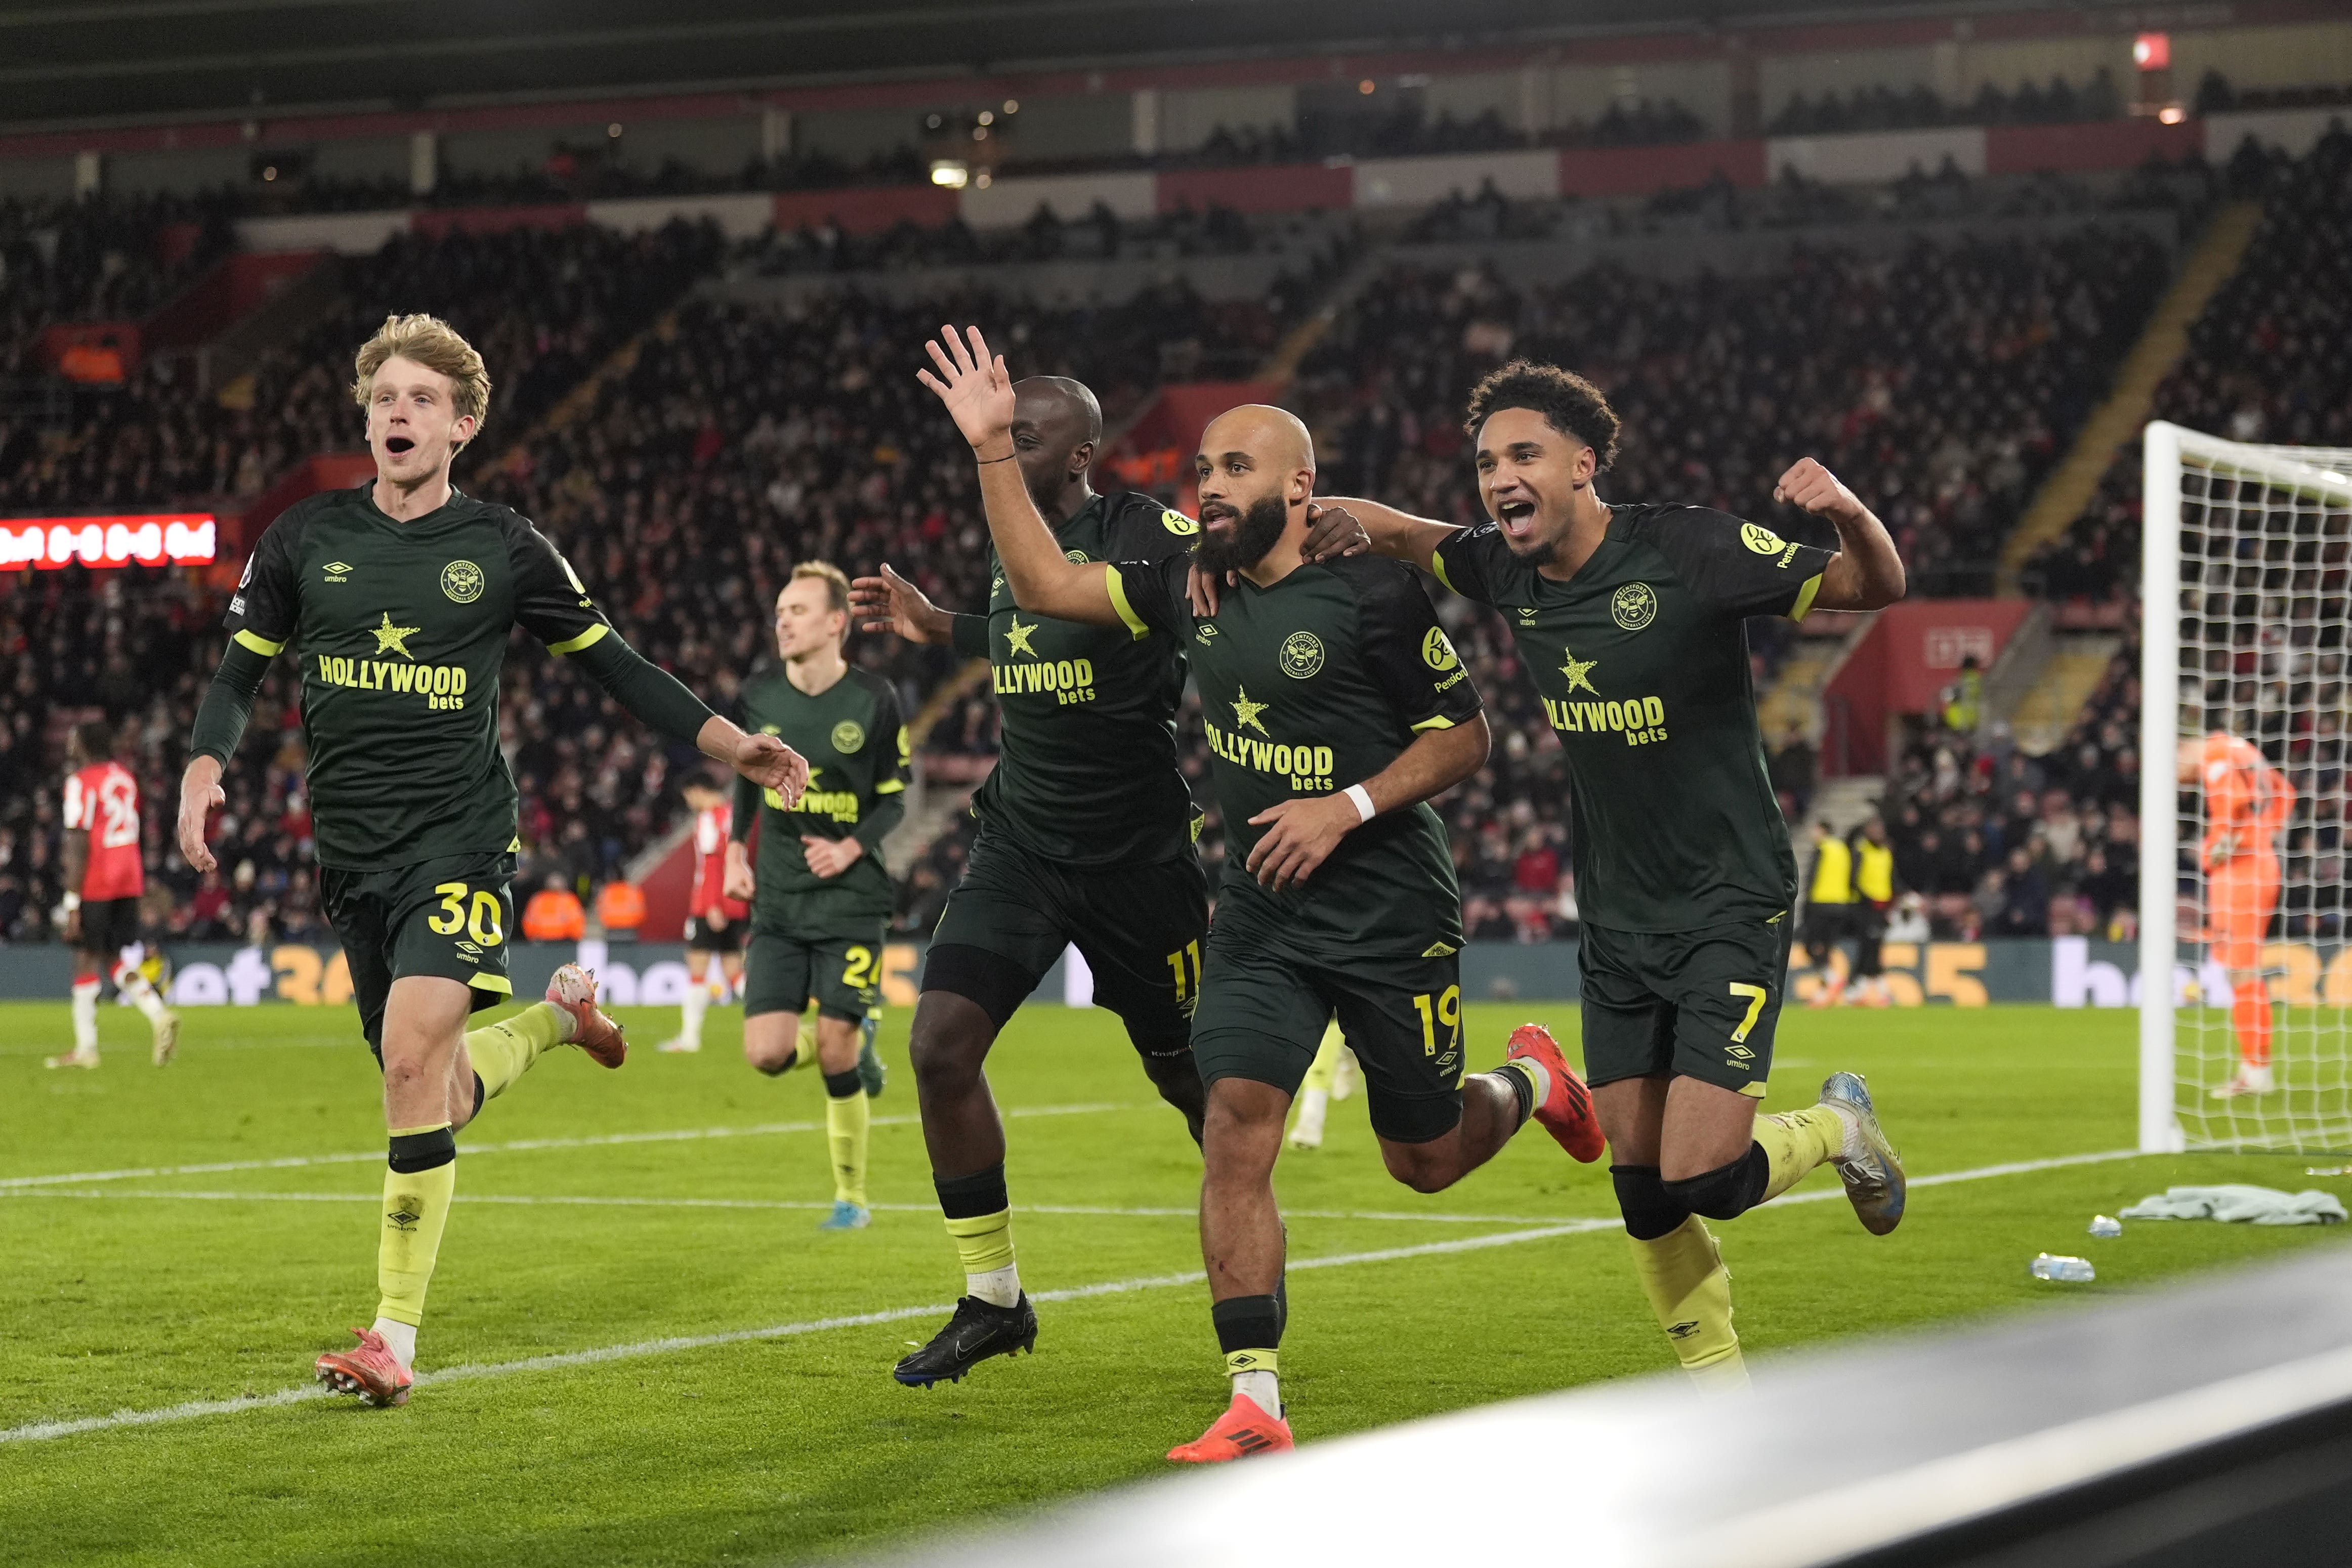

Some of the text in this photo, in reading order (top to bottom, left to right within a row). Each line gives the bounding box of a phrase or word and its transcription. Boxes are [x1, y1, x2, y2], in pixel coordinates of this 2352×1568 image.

[1068, 553, 1085, 561] NTFORD
[447, 563, 479, 575] BRENTFORD
[324, 575, 347, 583] umbro
[1616, 584, 1647, 600] BRENTFORD
[1520, 618, 1536, 626] umbro
[1619, 618, 1641, 627] FOOTBALL
[1196, 633, 1211, 647] umbro
[1288, 634, 1319, 648] BRENTFORD
[318, 654, 467, 695] HOLLYWOOD
[991, 658, 1094, 695] LLYWOOD
[1284, 662, 1316, 676] FOOTBALL CLUB
[429, 692, 464, 709] bets
[1057, 688, 1096, 705] bets
[1541, 695, 1665, 732] OLLYWOOD
[1625, 727, 1668, 746] bets
[1291, 773, 1334, 791] bets
[428, 882, 503, 947] 30
[456, 952, 480, 964] umbro
[1167, 939, 1201, 1003] 11
[1413, 984, 1460, 1056] 19
[1730, 982, 1767, 1043] 7
[1440, 1064, 1457, 1077] umbro
[1726, 1059, 1750, 1071] umbro
[387, 1223, 417, 1232] umbro
